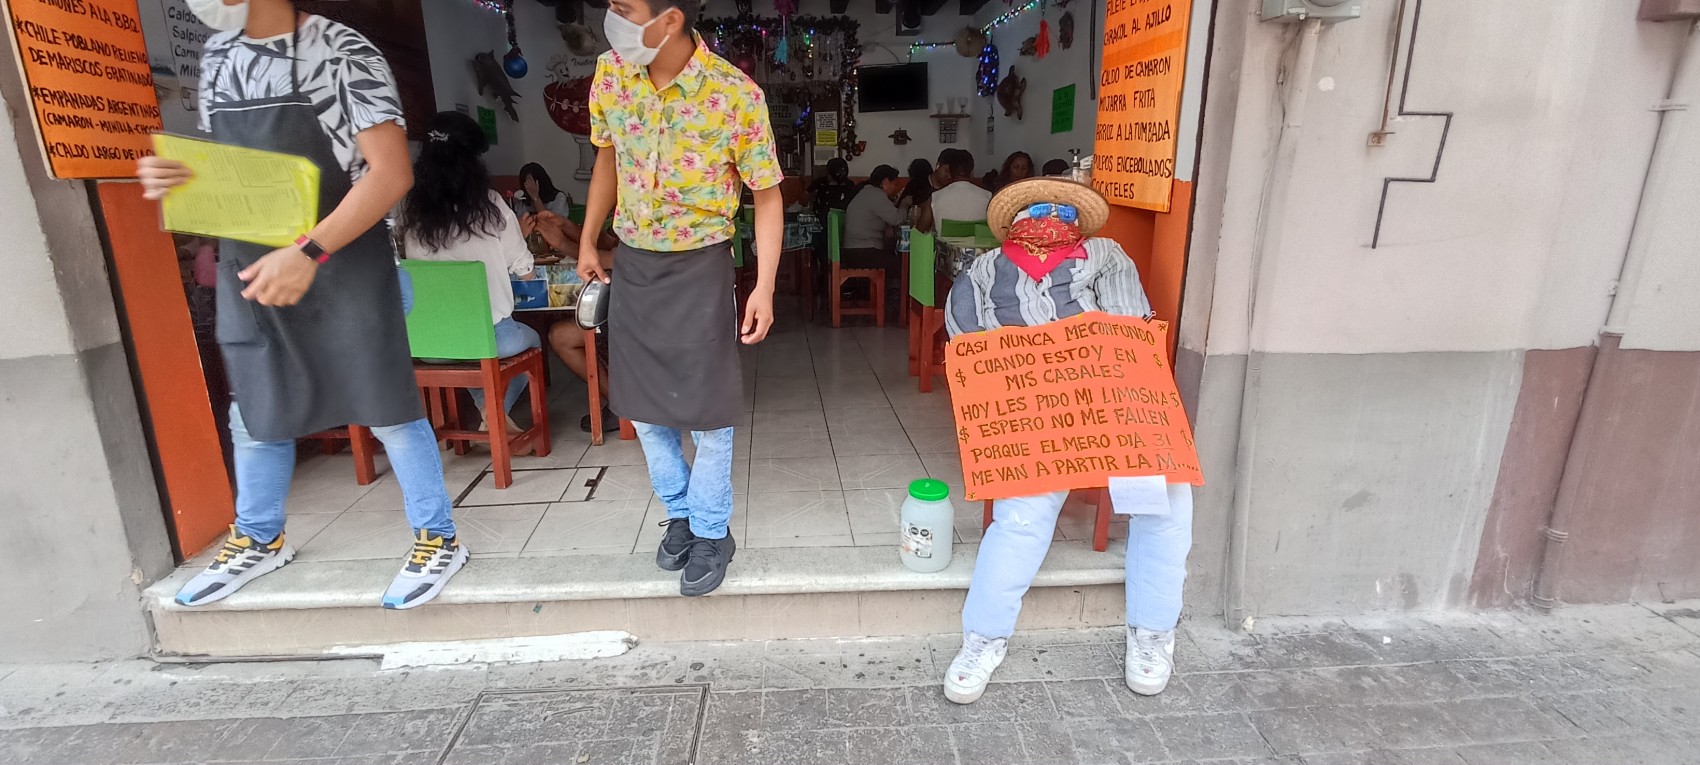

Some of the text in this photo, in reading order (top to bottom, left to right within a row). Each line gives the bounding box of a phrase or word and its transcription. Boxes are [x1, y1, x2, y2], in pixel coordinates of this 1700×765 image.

[112, 11, 140, 33] BBQ
[168, 6, 197, 24] Caldo
[1131, 17, 1142, 35] AL
[1145, 3, 1171, 32] AJILLO
[25, 20, 62, 46] CHILE
[61, 30, 112, 57] POBLANO
[105, 66, 153, 87] GRATINADO
[1101, 55, 1171, 87] CALDO DE CAMARON
[39, 87, 159, 119] EMPANADAS ARGENTINAS
[1133, 87, 1156, 109] FRITA
[1095, 123, 1114, 141] ARROZ
[1116, 123, 1122, 142] A
[55, 141, 90, 159] CALDO
[91, 142, 122, 160] LARGO
[122, 148, 135, 161] DE
[1116, 156, 1173, 179] ENCEBOLLADOS
[955, 339, 988, 357] CASI
[999, 332, 1055, 350] NUNCA
[973, 353, 1036, 376] CUANDO
[1043, 344, 1104, 365] ESTOY
[1114, 347, 1138, 364] EN
[1004, 364, 1125, 392] MIS CABALES
[961, 401, 989, 422] HOY
[996, 396, 1028, 417] LES
[1036, 392, 1069, 411] PIDO
[1074, 388, 1094, 408] MI
[1102, 387, 1168, 408] LIMOSNA
[976, 417, 1045, 439] ESPERO
[1051, 412, 1075, 429] NO
[1081, 408, 1108, 426] ME
[1114, 407, 1171, 427] FALLEN
[970, 441, 1031, 464] PORQUE
[1064, 433, 1111, 452] MERO
[1118, 431, 1146, 448] DIA
[972, 470, 995, 486] ME
[998, 464, 1029, 481] VAN
[1036, 461, 1050, 478] A
[1050, 456, 1120, 475] PARTIR
[1126, 453, 1152, 469] LA
